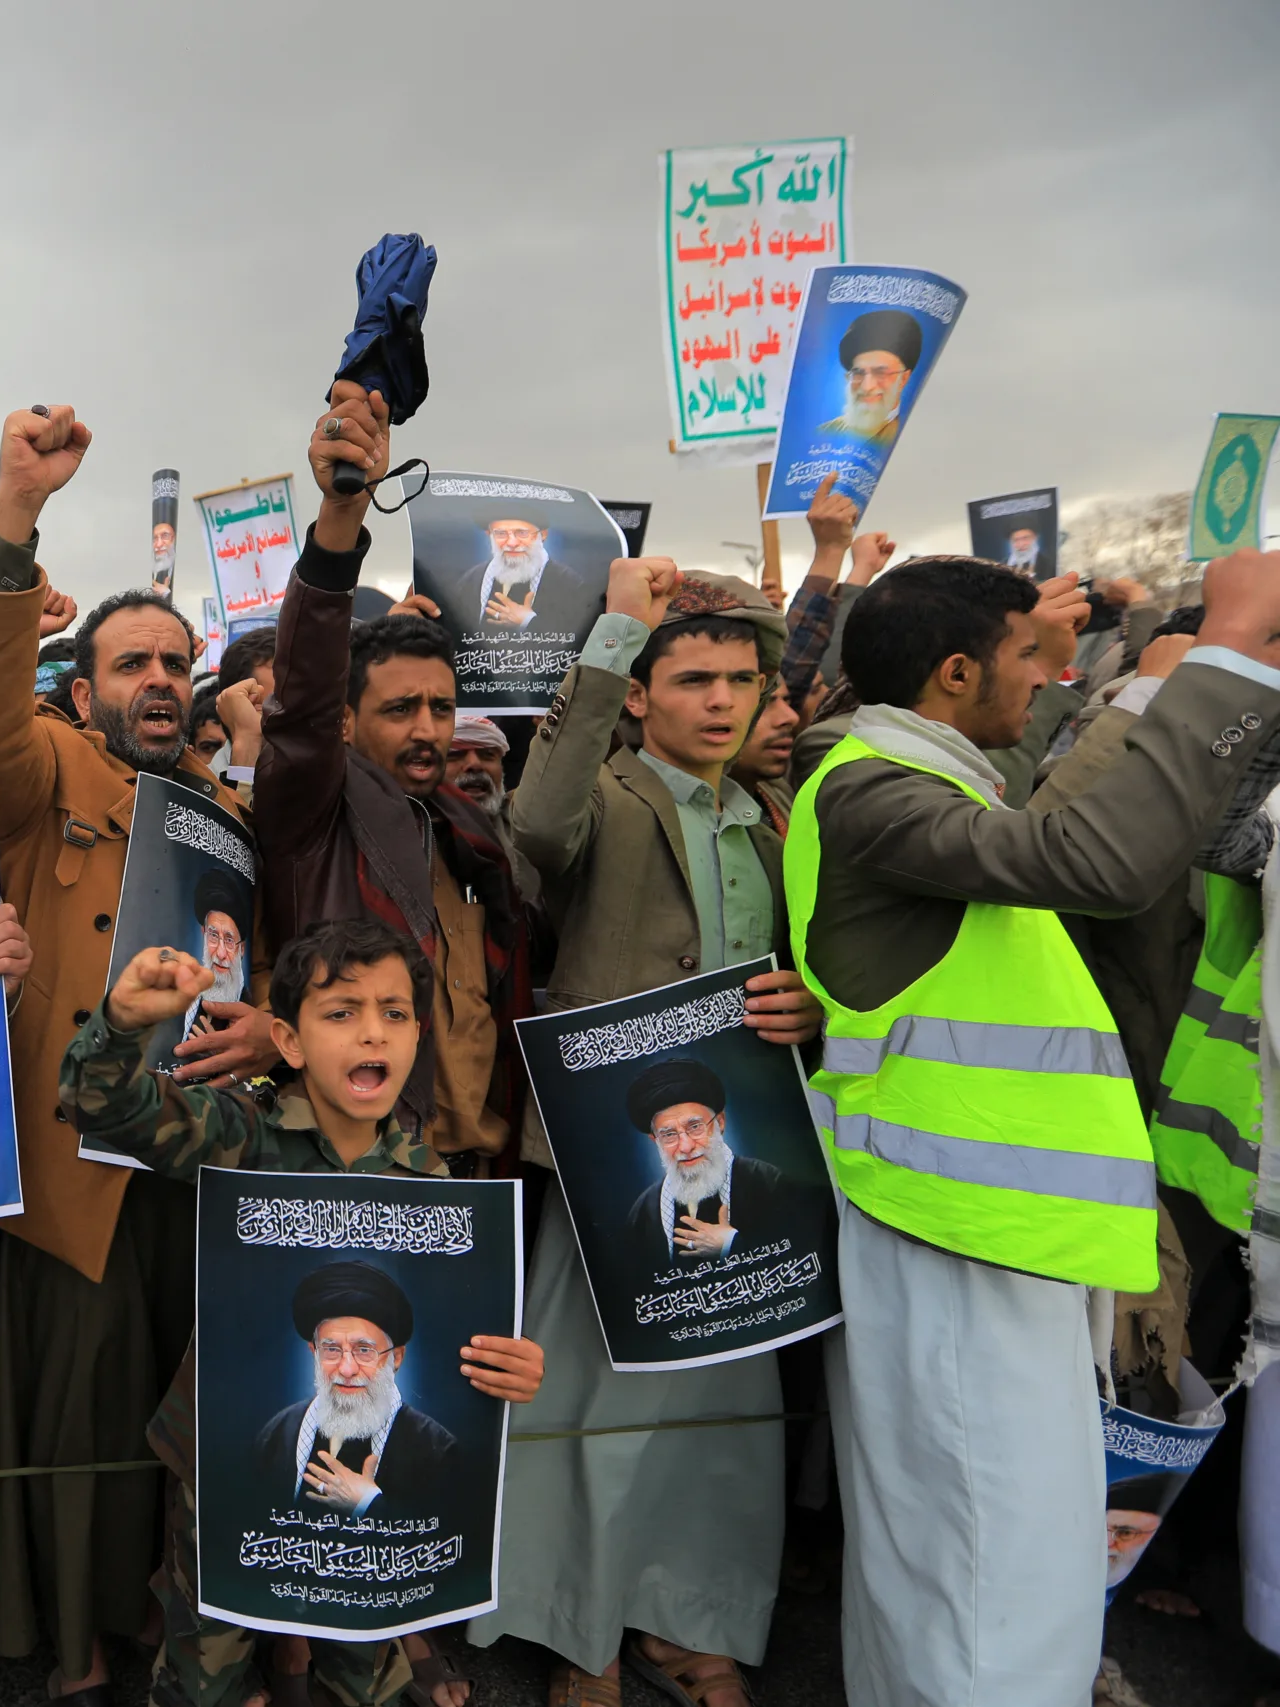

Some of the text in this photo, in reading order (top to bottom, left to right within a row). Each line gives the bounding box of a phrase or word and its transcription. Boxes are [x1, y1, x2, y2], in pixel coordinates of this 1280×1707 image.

[675, 148, 835, 224] الله أكبر
[768, 221, 835, 261] الموت
[208, 489, 286, 532] قاطعوا
